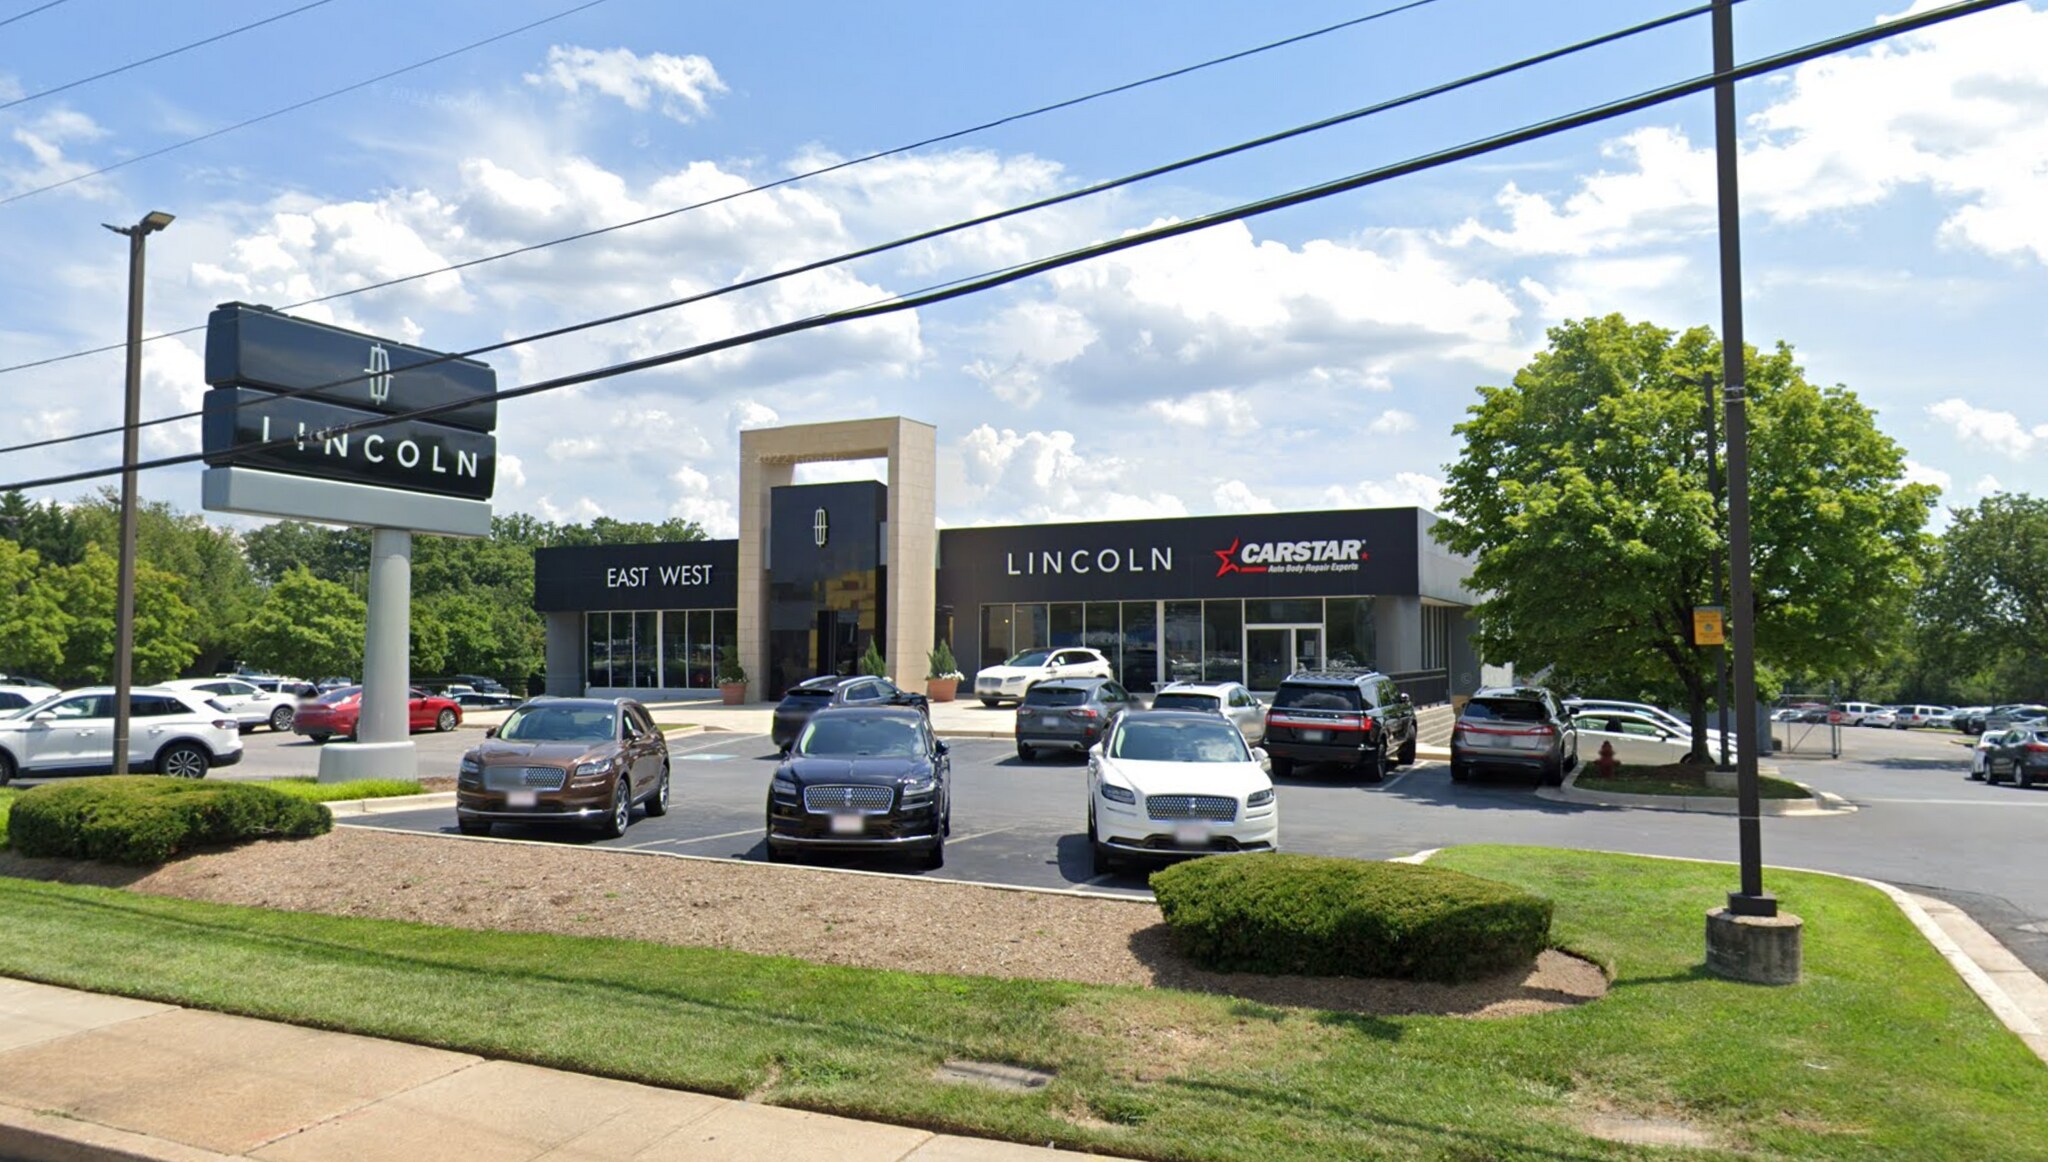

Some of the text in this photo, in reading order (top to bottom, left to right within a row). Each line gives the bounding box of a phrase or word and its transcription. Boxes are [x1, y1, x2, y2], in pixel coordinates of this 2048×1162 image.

[262, 416, 478, 478] LINCOLN
[1007, 547, 1172, 575] LINCOLN
[1241, 539, 1362, 564] CARSTAR
[607, 564, 713, 588] EAST WEST
[1268, 562, 1359, 574] Auto Body Repair Experts
